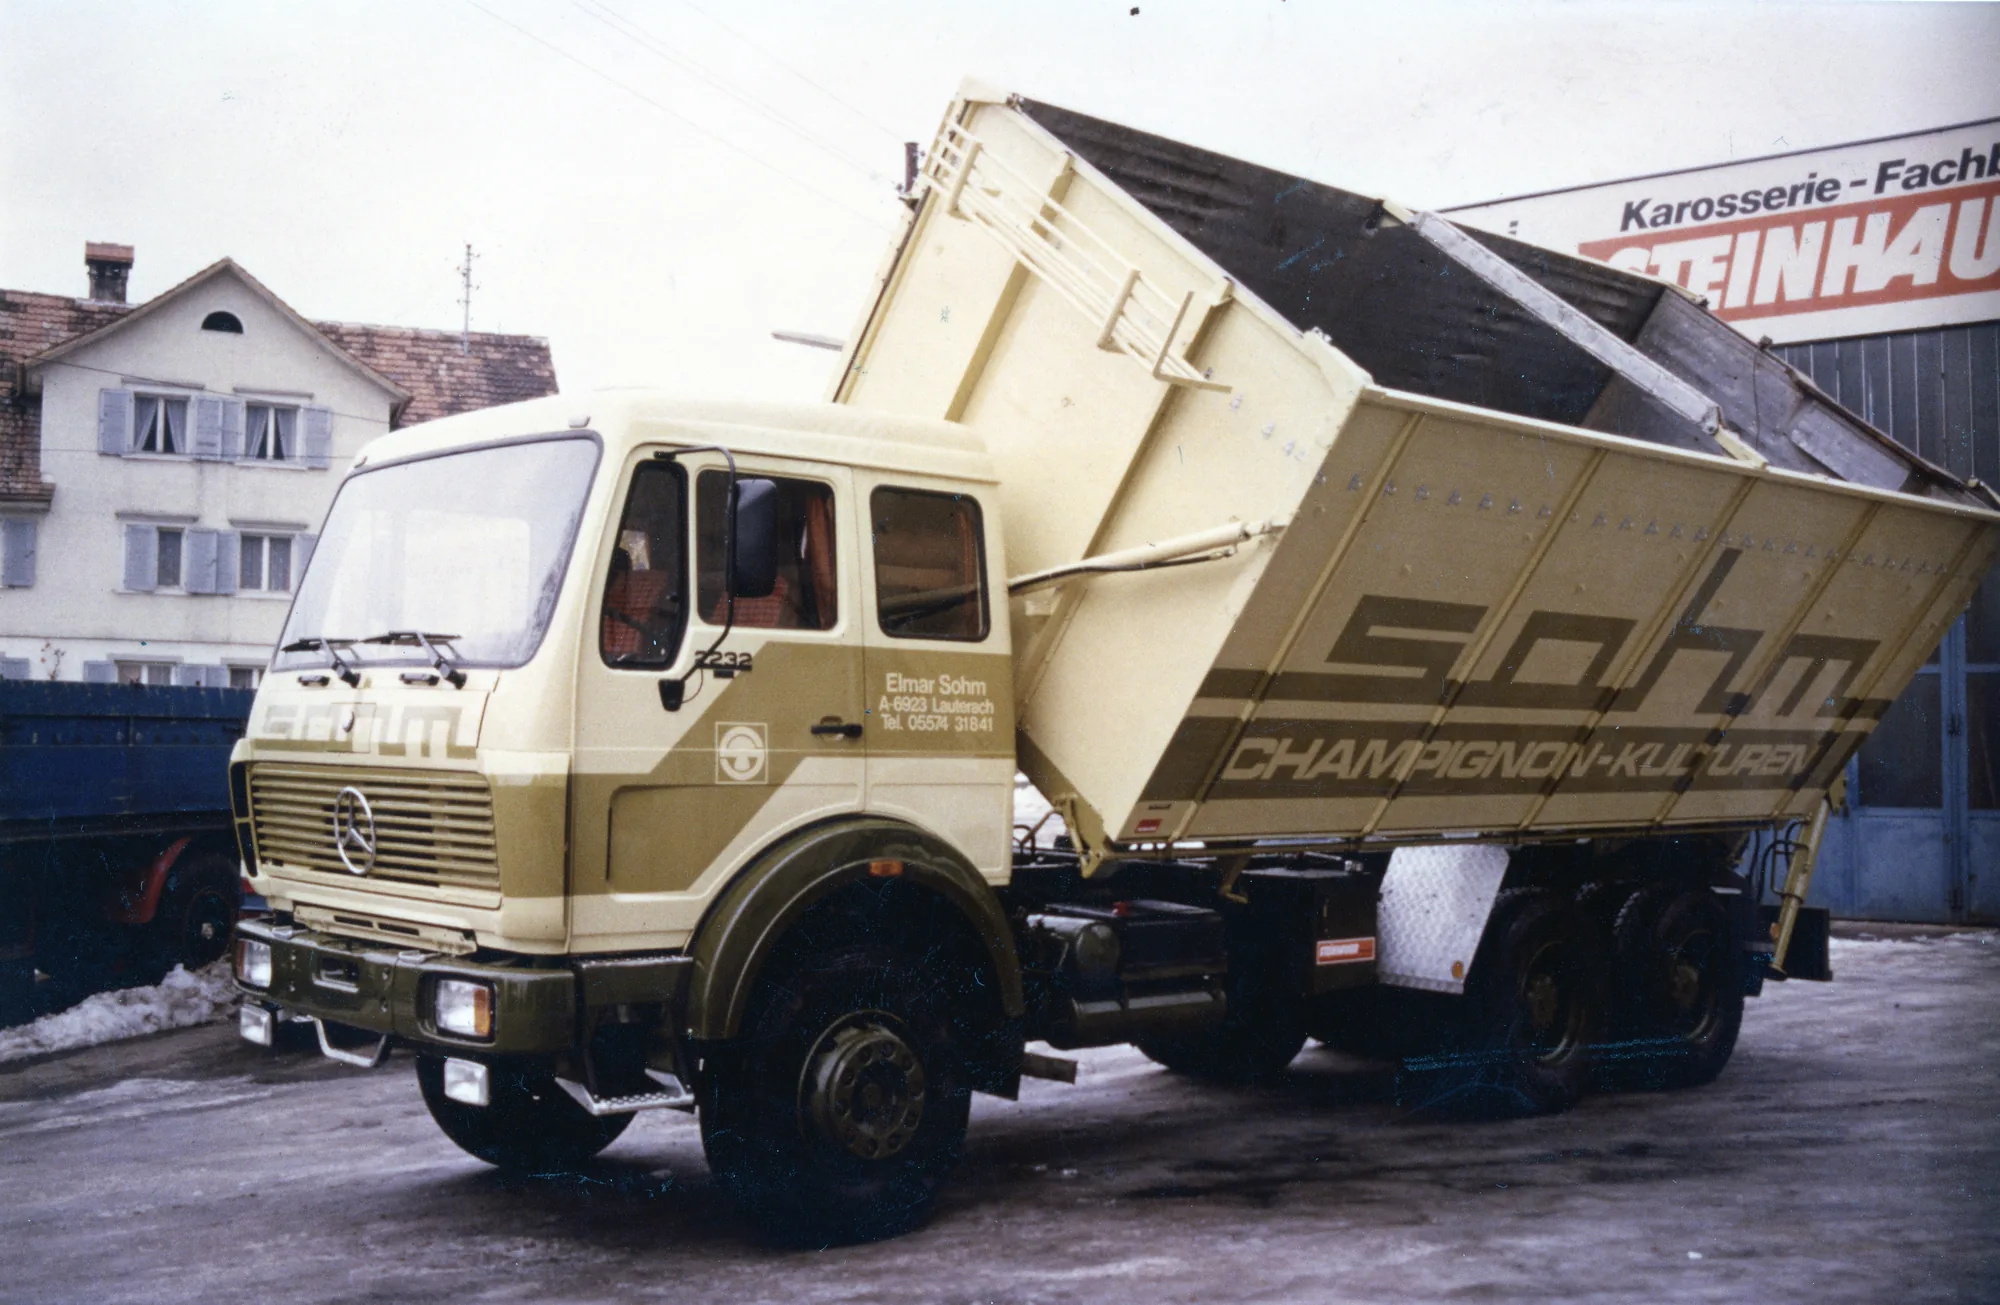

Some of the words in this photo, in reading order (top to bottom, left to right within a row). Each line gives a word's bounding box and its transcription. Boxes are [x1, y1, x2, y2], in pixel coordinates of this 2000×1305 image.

[1620, 171, 1841, 232] Karosserie
[885, 672, 935, 694] Elmar
[938, 673, 987, 696] Sohm
[879, 695, 928, 713] A-6923
[932, 696, 995, 715] Lauterach
[881, 712, 904, 730] Tel.
